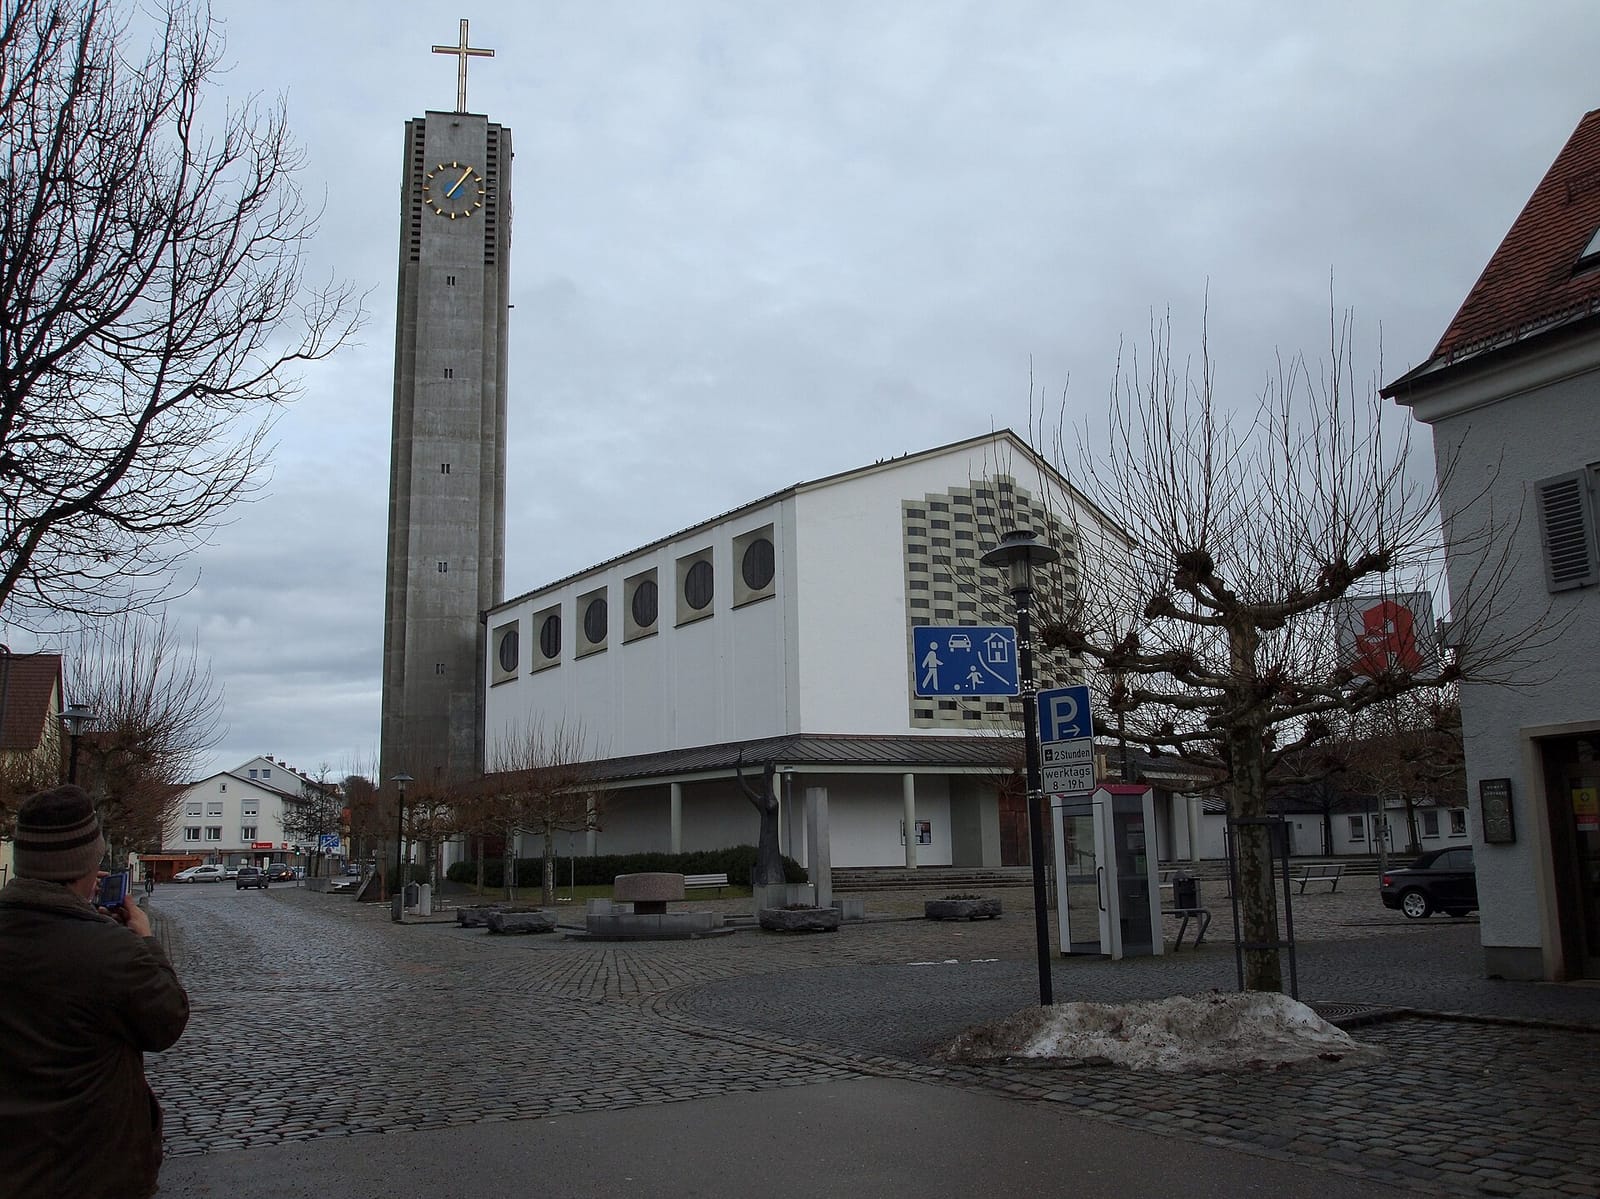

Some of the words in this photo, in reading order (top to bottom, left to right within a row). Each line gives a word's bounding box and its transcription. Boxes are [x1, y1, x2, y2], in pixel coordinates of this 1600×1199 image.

[1050, 695, 1078, 740] P
[1060, 748, 1090, 760] Stunden
[1045, 767, 1091, 779] werktags
[1052, 781, 1059, 790] 8
